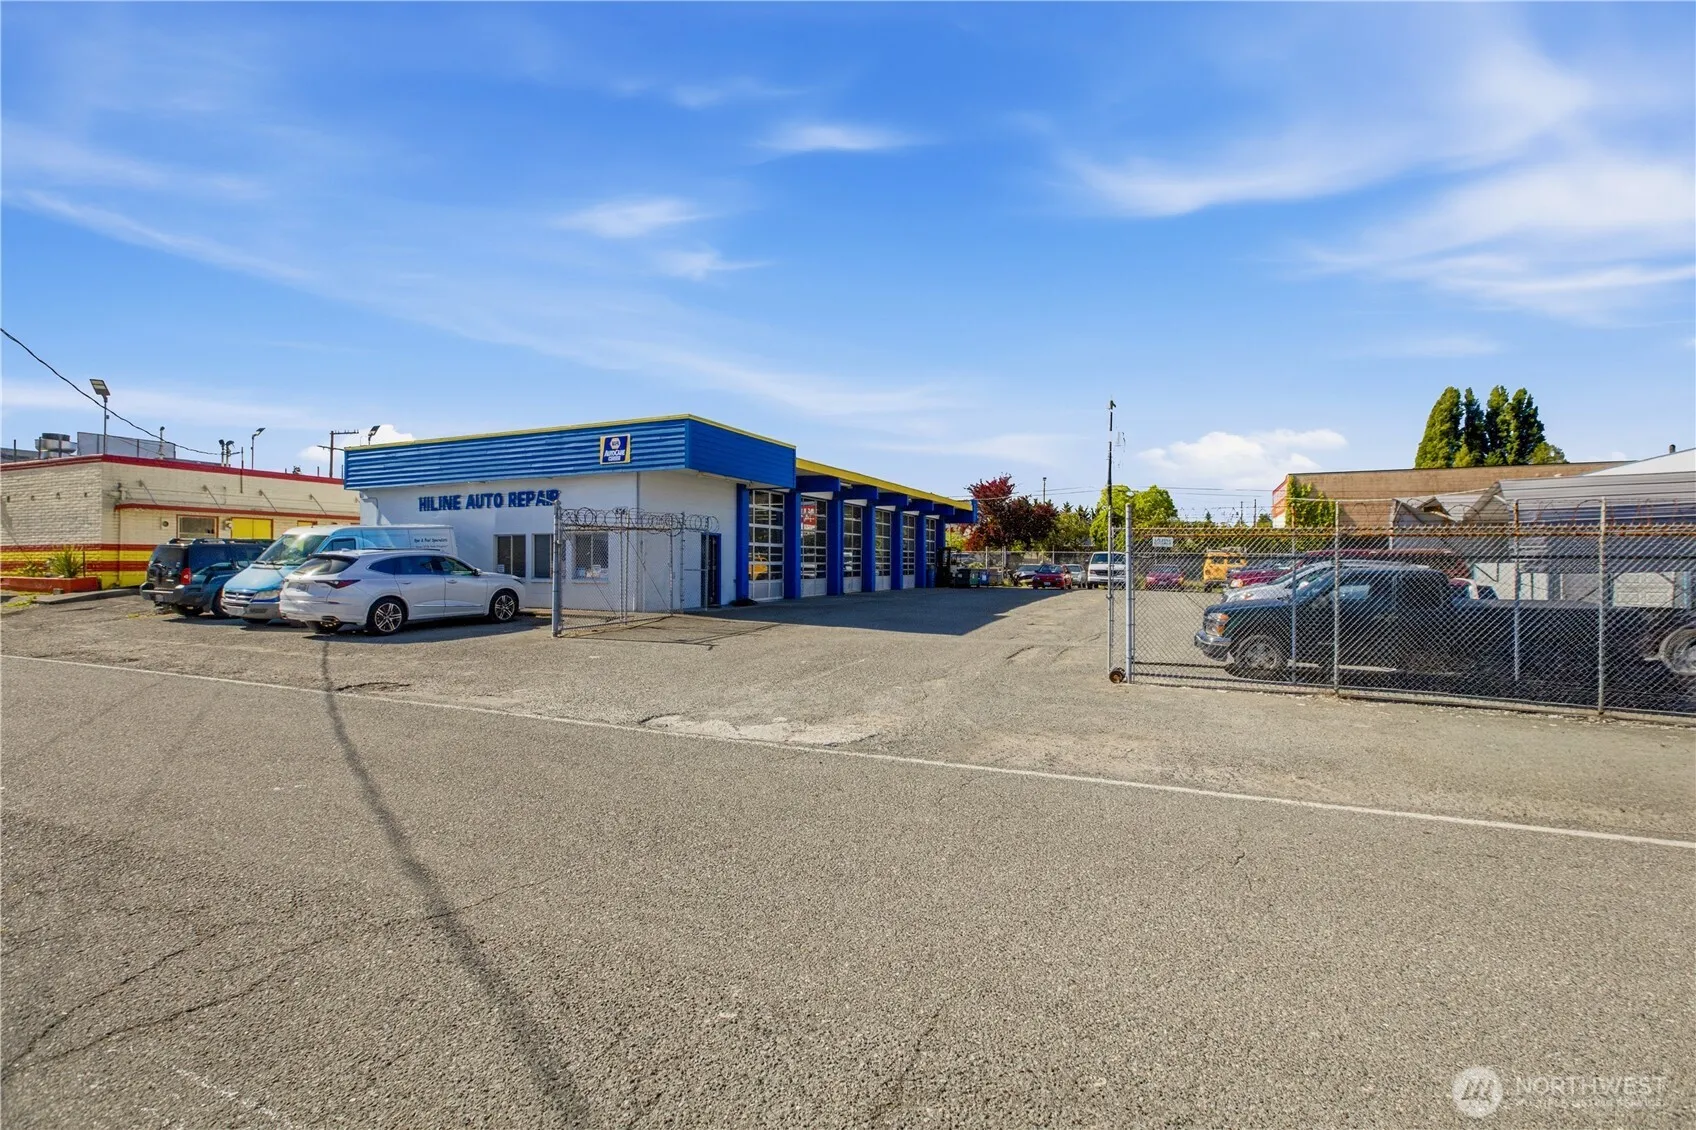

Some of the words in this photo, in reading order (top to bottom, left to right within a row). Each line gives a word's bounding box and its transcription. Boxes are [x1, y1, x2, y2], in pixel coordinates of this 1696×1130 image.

[418, 495, 462, 511] HILINE
[465, 492, 504, 510] AUTO
[508, 489, 560, 507] REPAIR
